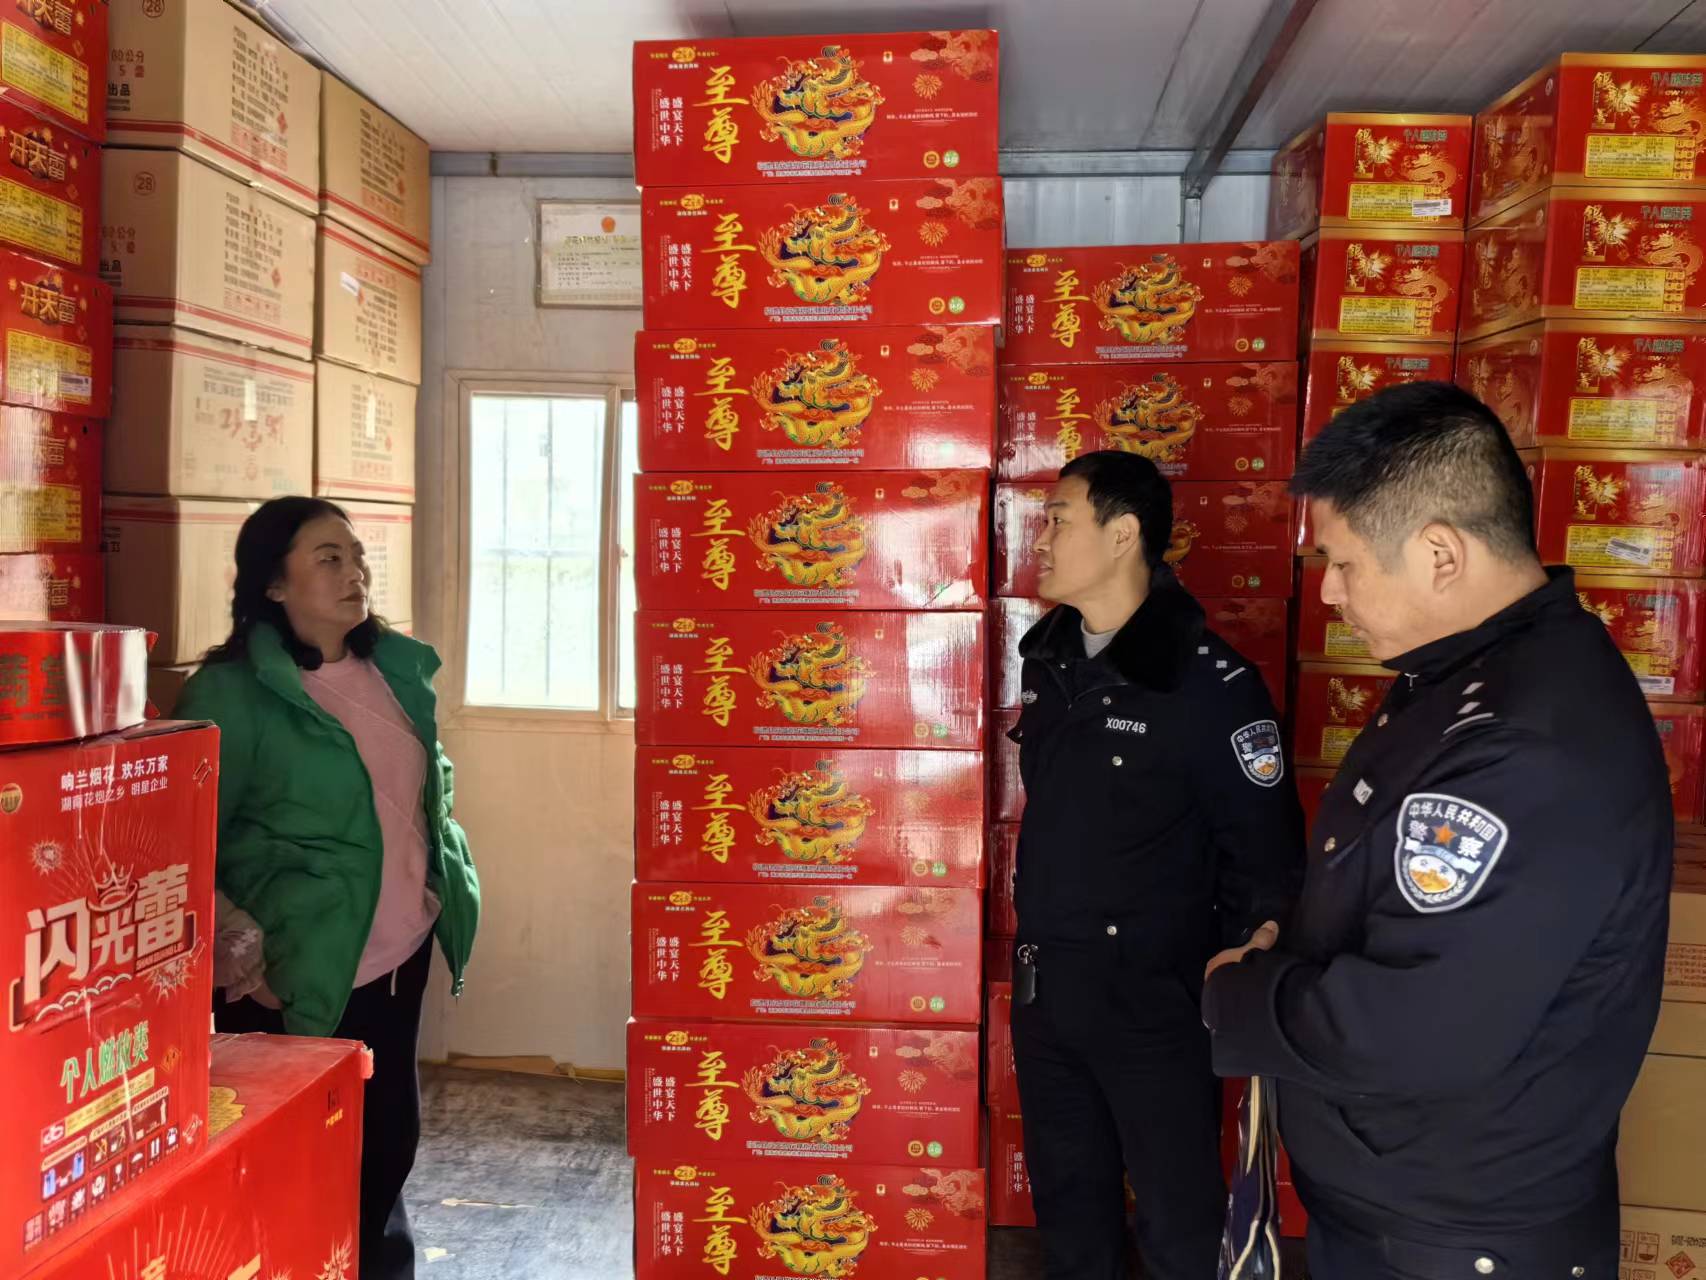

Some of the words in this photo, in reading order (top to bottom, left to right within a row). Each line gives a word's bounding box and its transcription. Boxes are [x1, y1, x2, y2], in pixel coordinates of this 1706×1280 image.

[693, 66, 750, 163] 至尊
[702, 213, 757, 308] 至尊
[1043, 270, 1090, 348] 至尊
[693, 357, 750, 450] 至尊
[690, 499, 746, 590] 至尊
[692, 637, 747, 727] 至尊
[1105, 717, 1147, 734] X00746
[121, 754, 169, 780] 欢乐万家
[131, 776, 168, 796] 明星企业
[691, 774, 746, 863] 至尊
[1408, 801, 1499, 842] 中华人民共和国
[688, 911, 743, 999] 至尊
[684, 1051, 740, 1141] 至尊
[692, 1186, 748, 1275] 至尊
